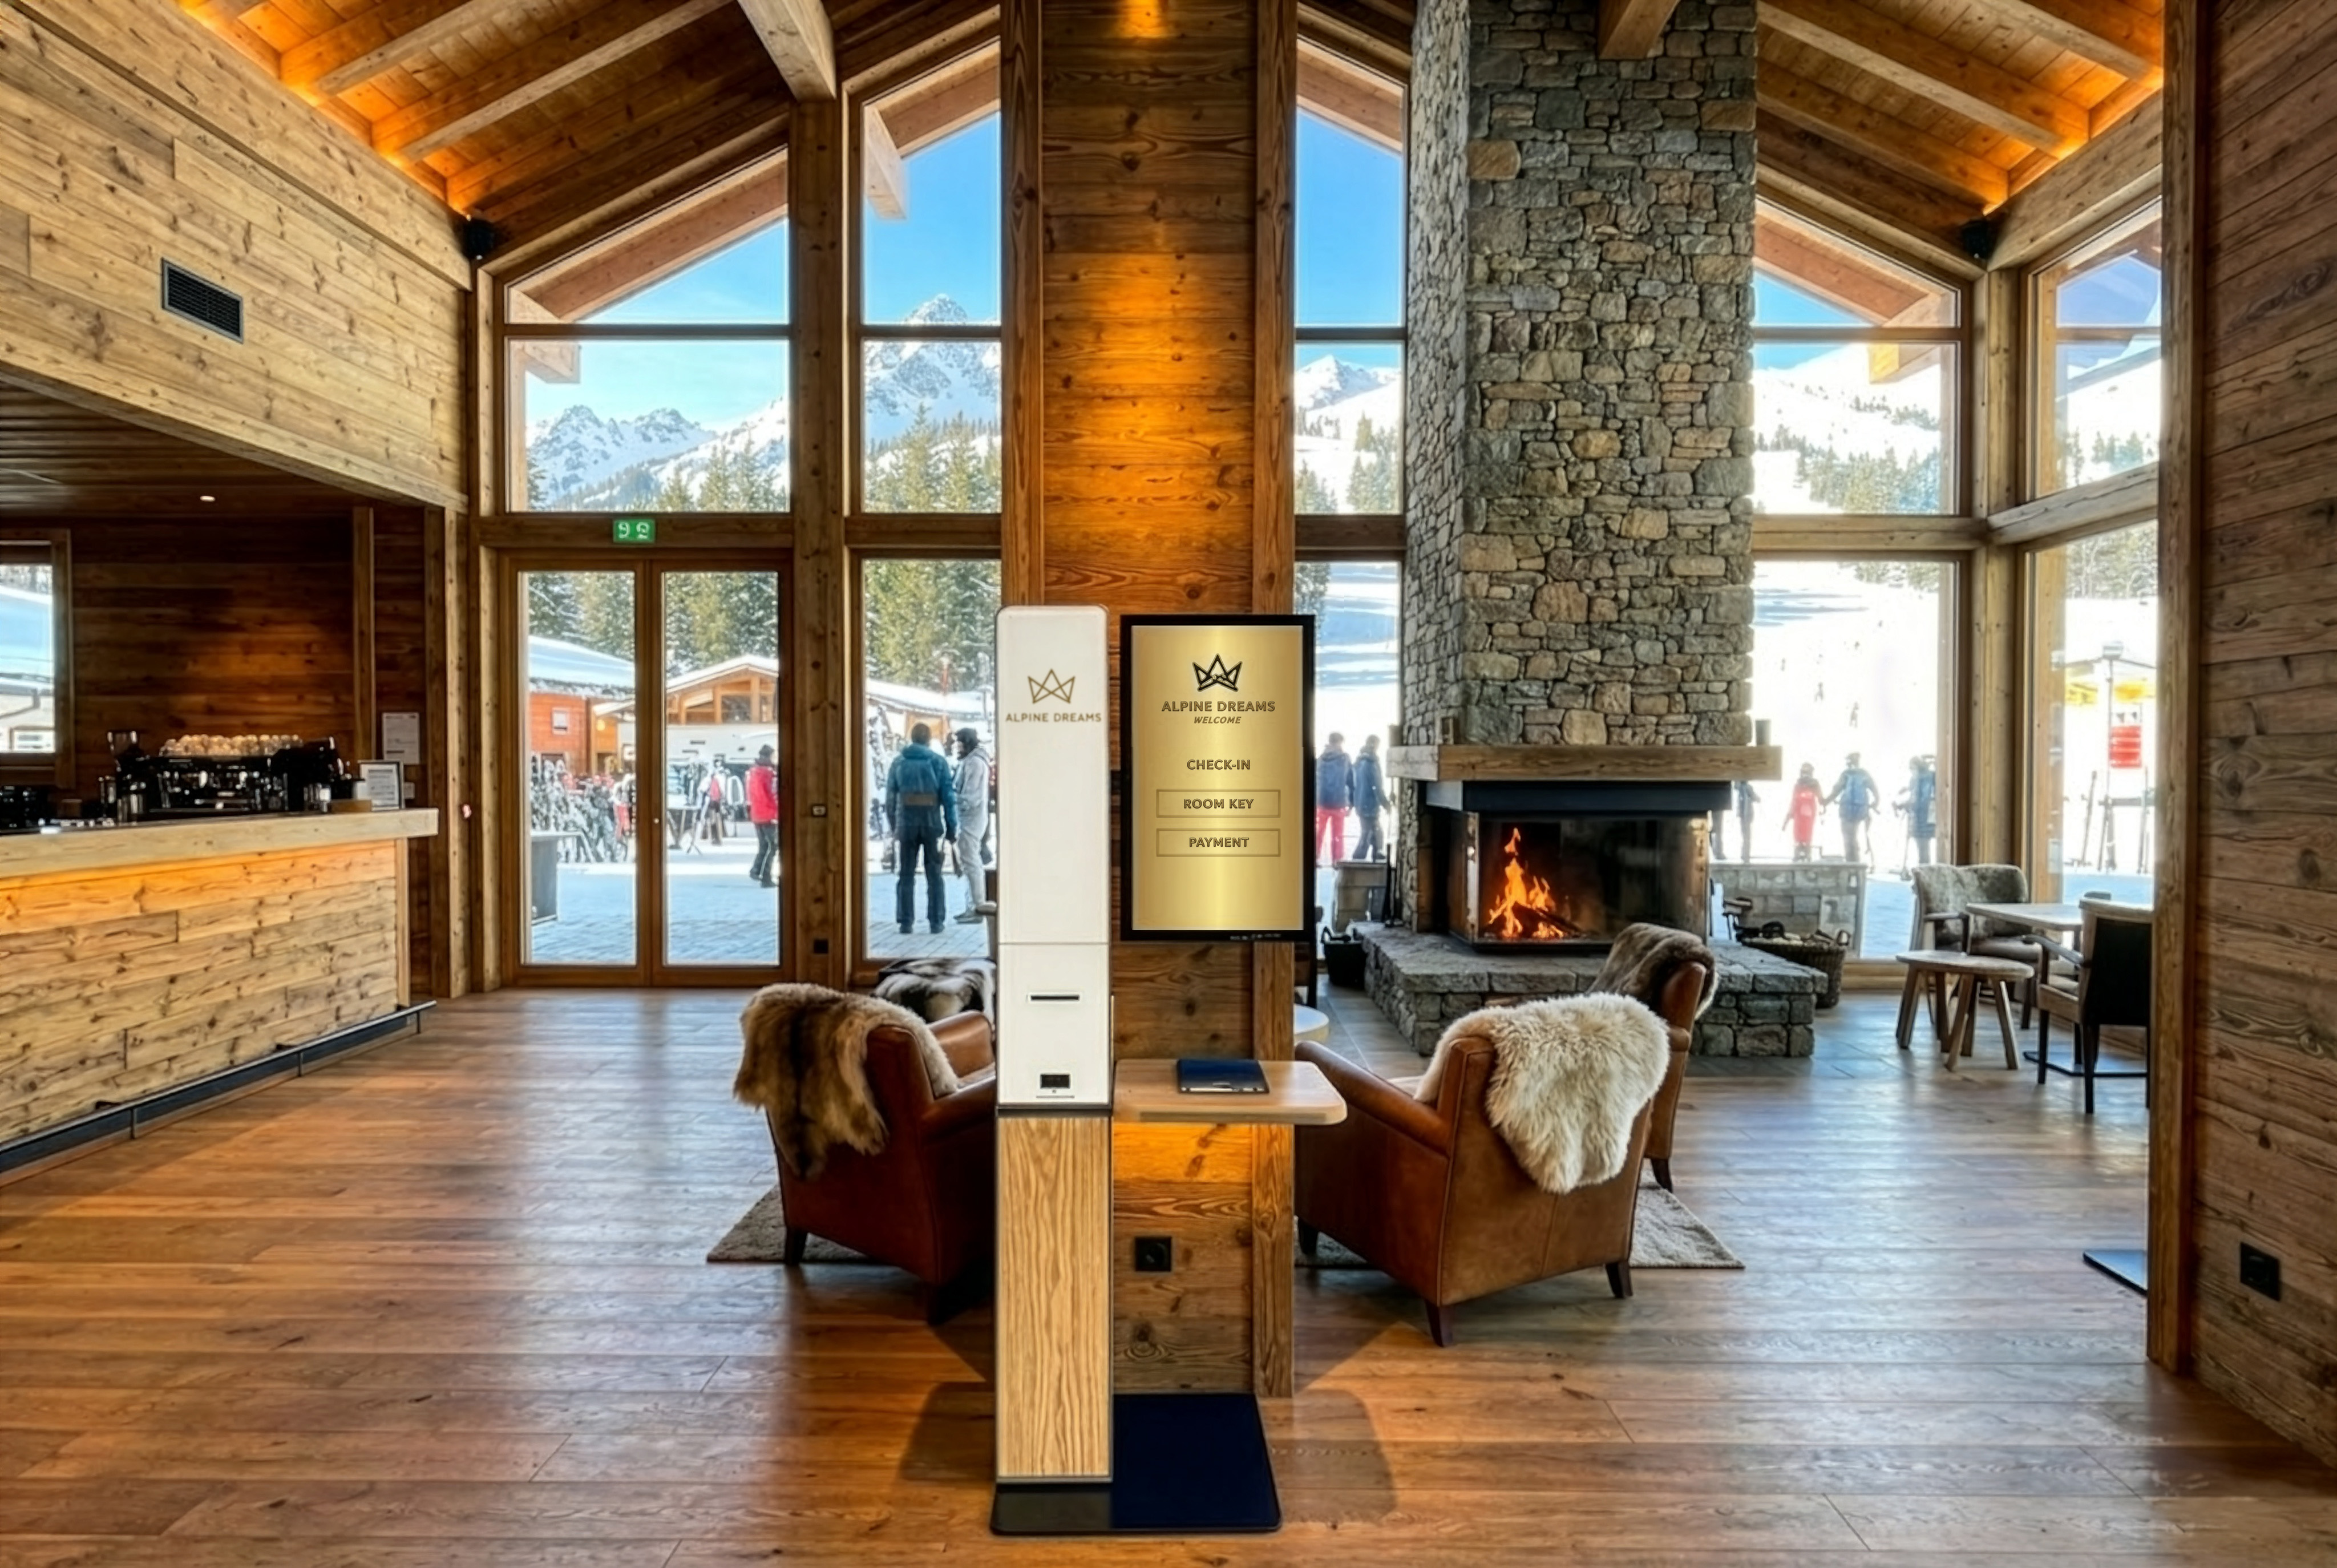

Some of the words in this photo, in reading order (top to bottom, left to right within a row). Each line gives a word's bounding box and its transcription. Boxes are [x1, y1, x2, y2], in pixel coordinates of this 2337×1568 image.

[1162, 701, 1212, 712] ALPINE
[1217, 700, 1275, 712] DREAMS
[1005, 713, 1049, 722] ALPINE
[1053, 713, 1102, 722] DREAMS
[1187, 759, 1251, 770] CHECK-IN
[1183, 798, 1224, 809] ROOM
[1229, 799, 1254, 809] KEY
[1189, 837, 1250, 847] PAYMENT
